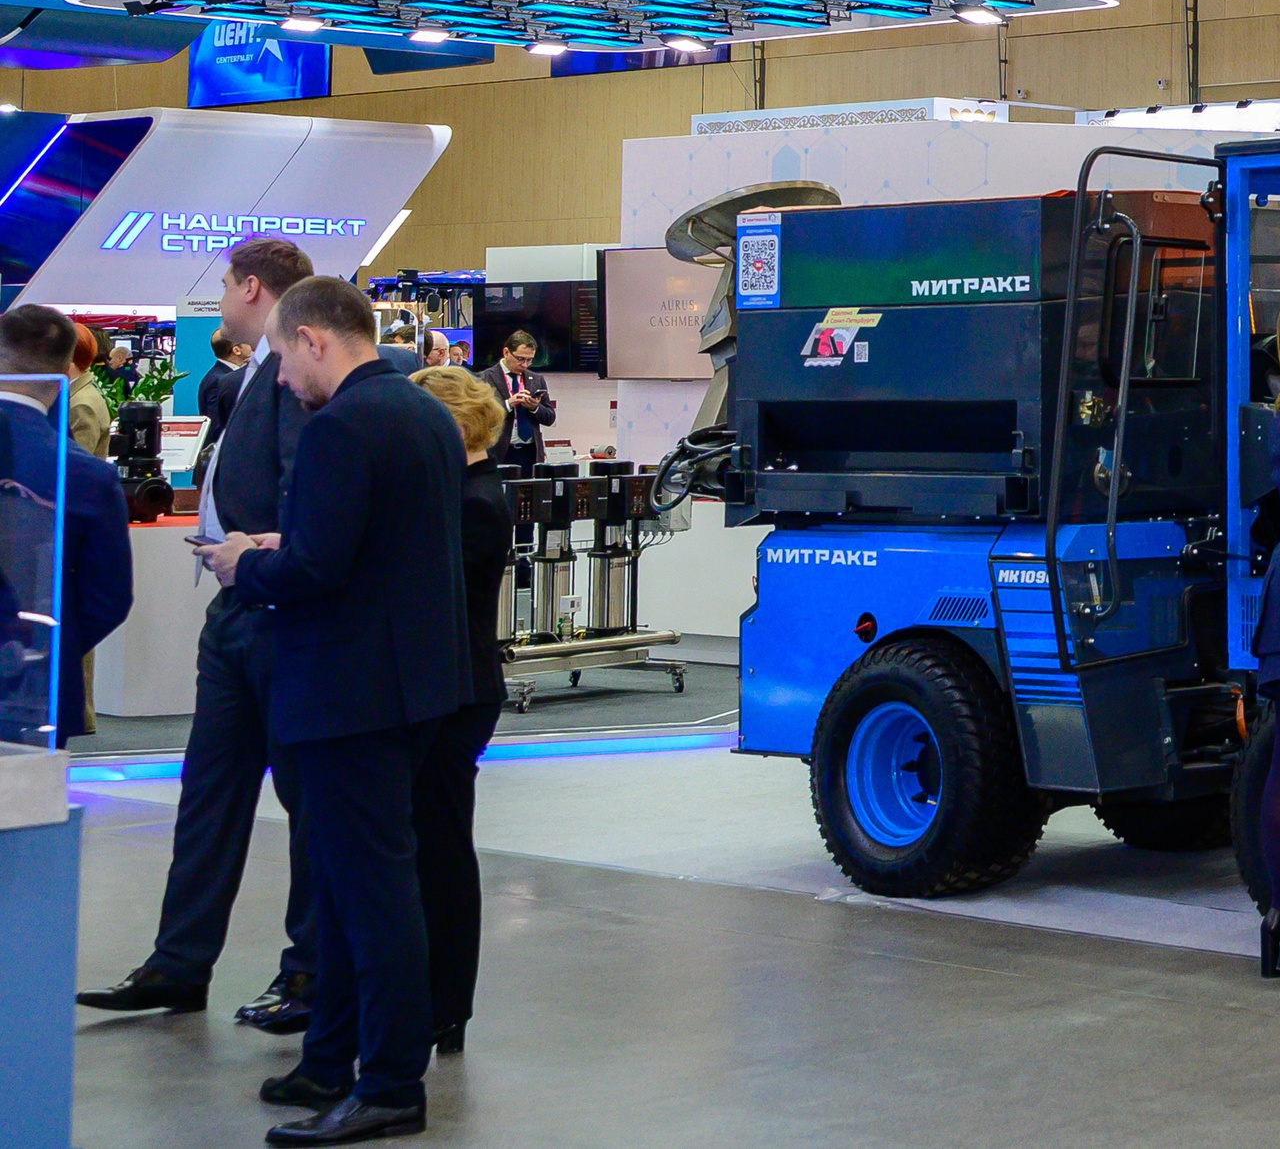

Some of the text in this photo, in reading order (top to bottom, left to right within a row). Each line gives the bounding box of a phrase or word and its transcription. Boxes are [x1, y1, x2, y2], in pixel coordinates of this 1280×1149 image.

[162, 212, 367, 236] НАЦПРОЕКТ
[911, 275, 1030, 297] МИТРАКС
[660, 300, 695, 311] AURUS
[766, 548, 877, 567] МИТРАКС
